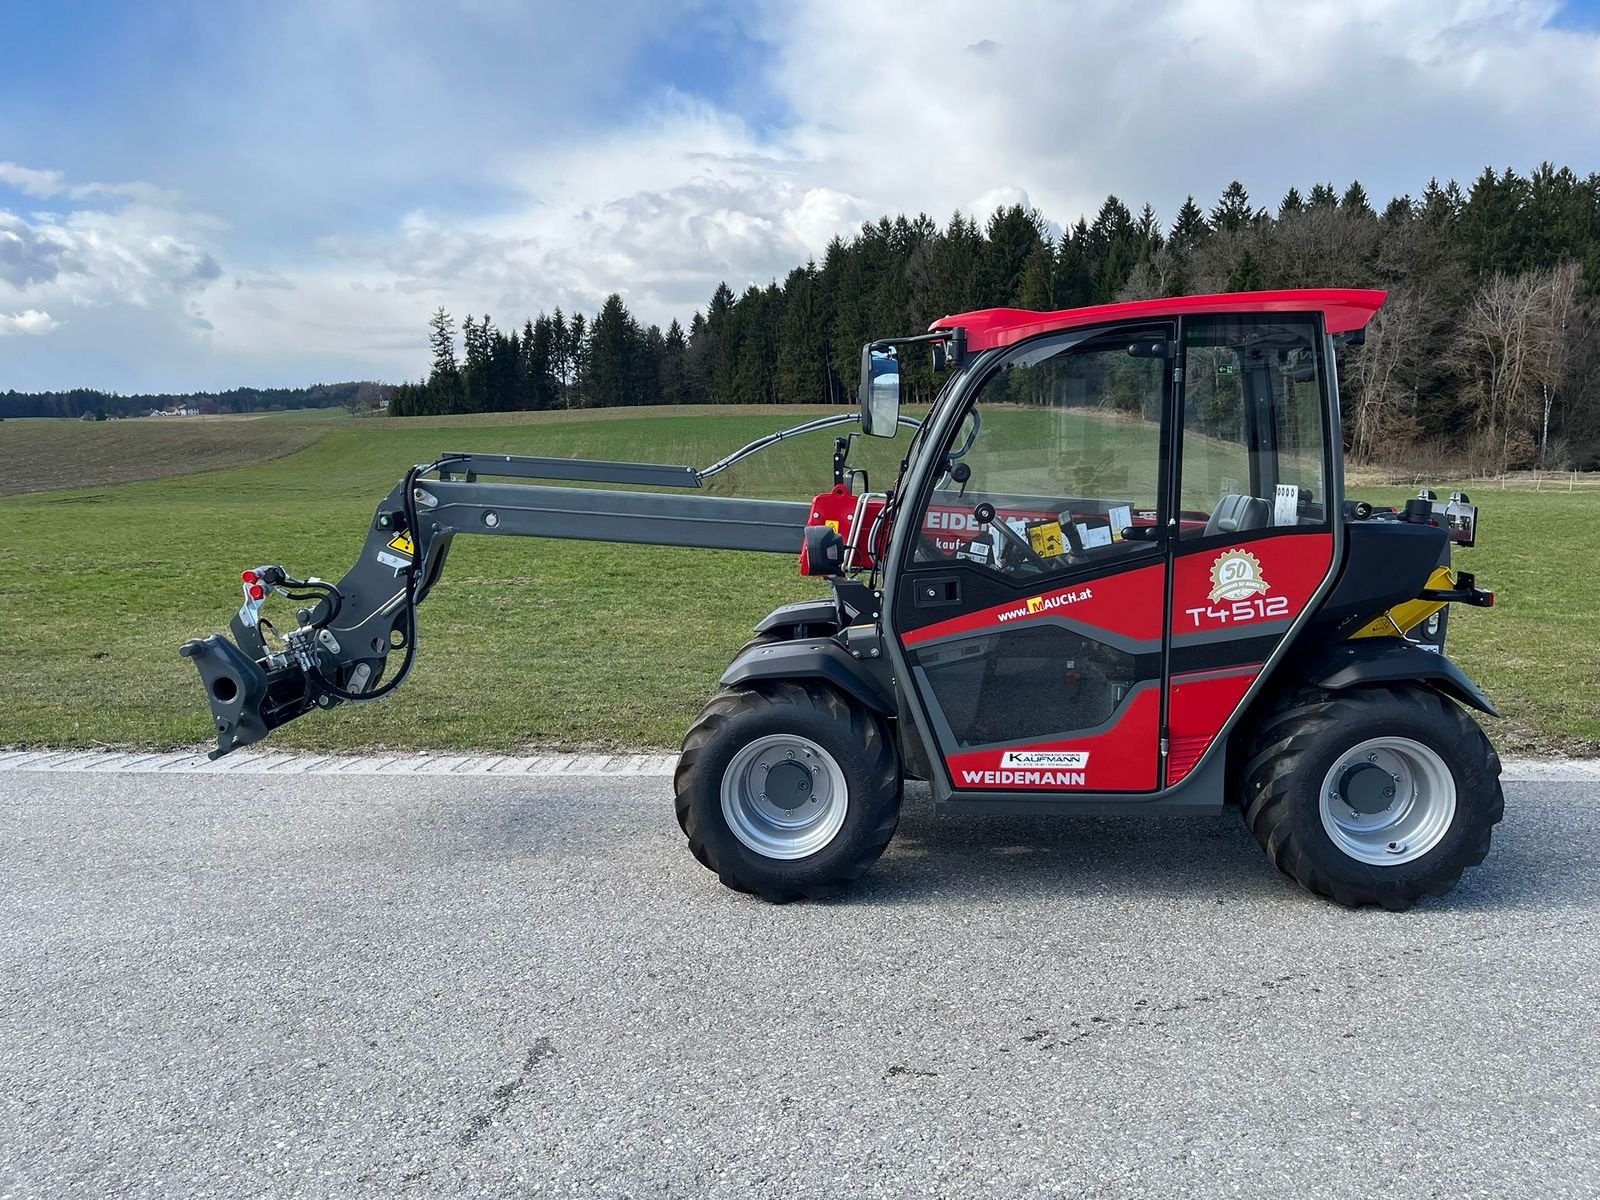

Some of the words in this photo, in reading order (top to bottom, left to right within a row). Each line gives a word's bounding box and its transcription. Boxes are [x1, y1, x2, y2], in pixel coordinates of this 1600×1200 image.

[1225, 562, 1247, 581] 50
[997, 588, 1093, 622] www.MAUCH.at
[1186, 597, 1289, 627] T4512
[962, 770, 1085, 785] WEIDEMANN
